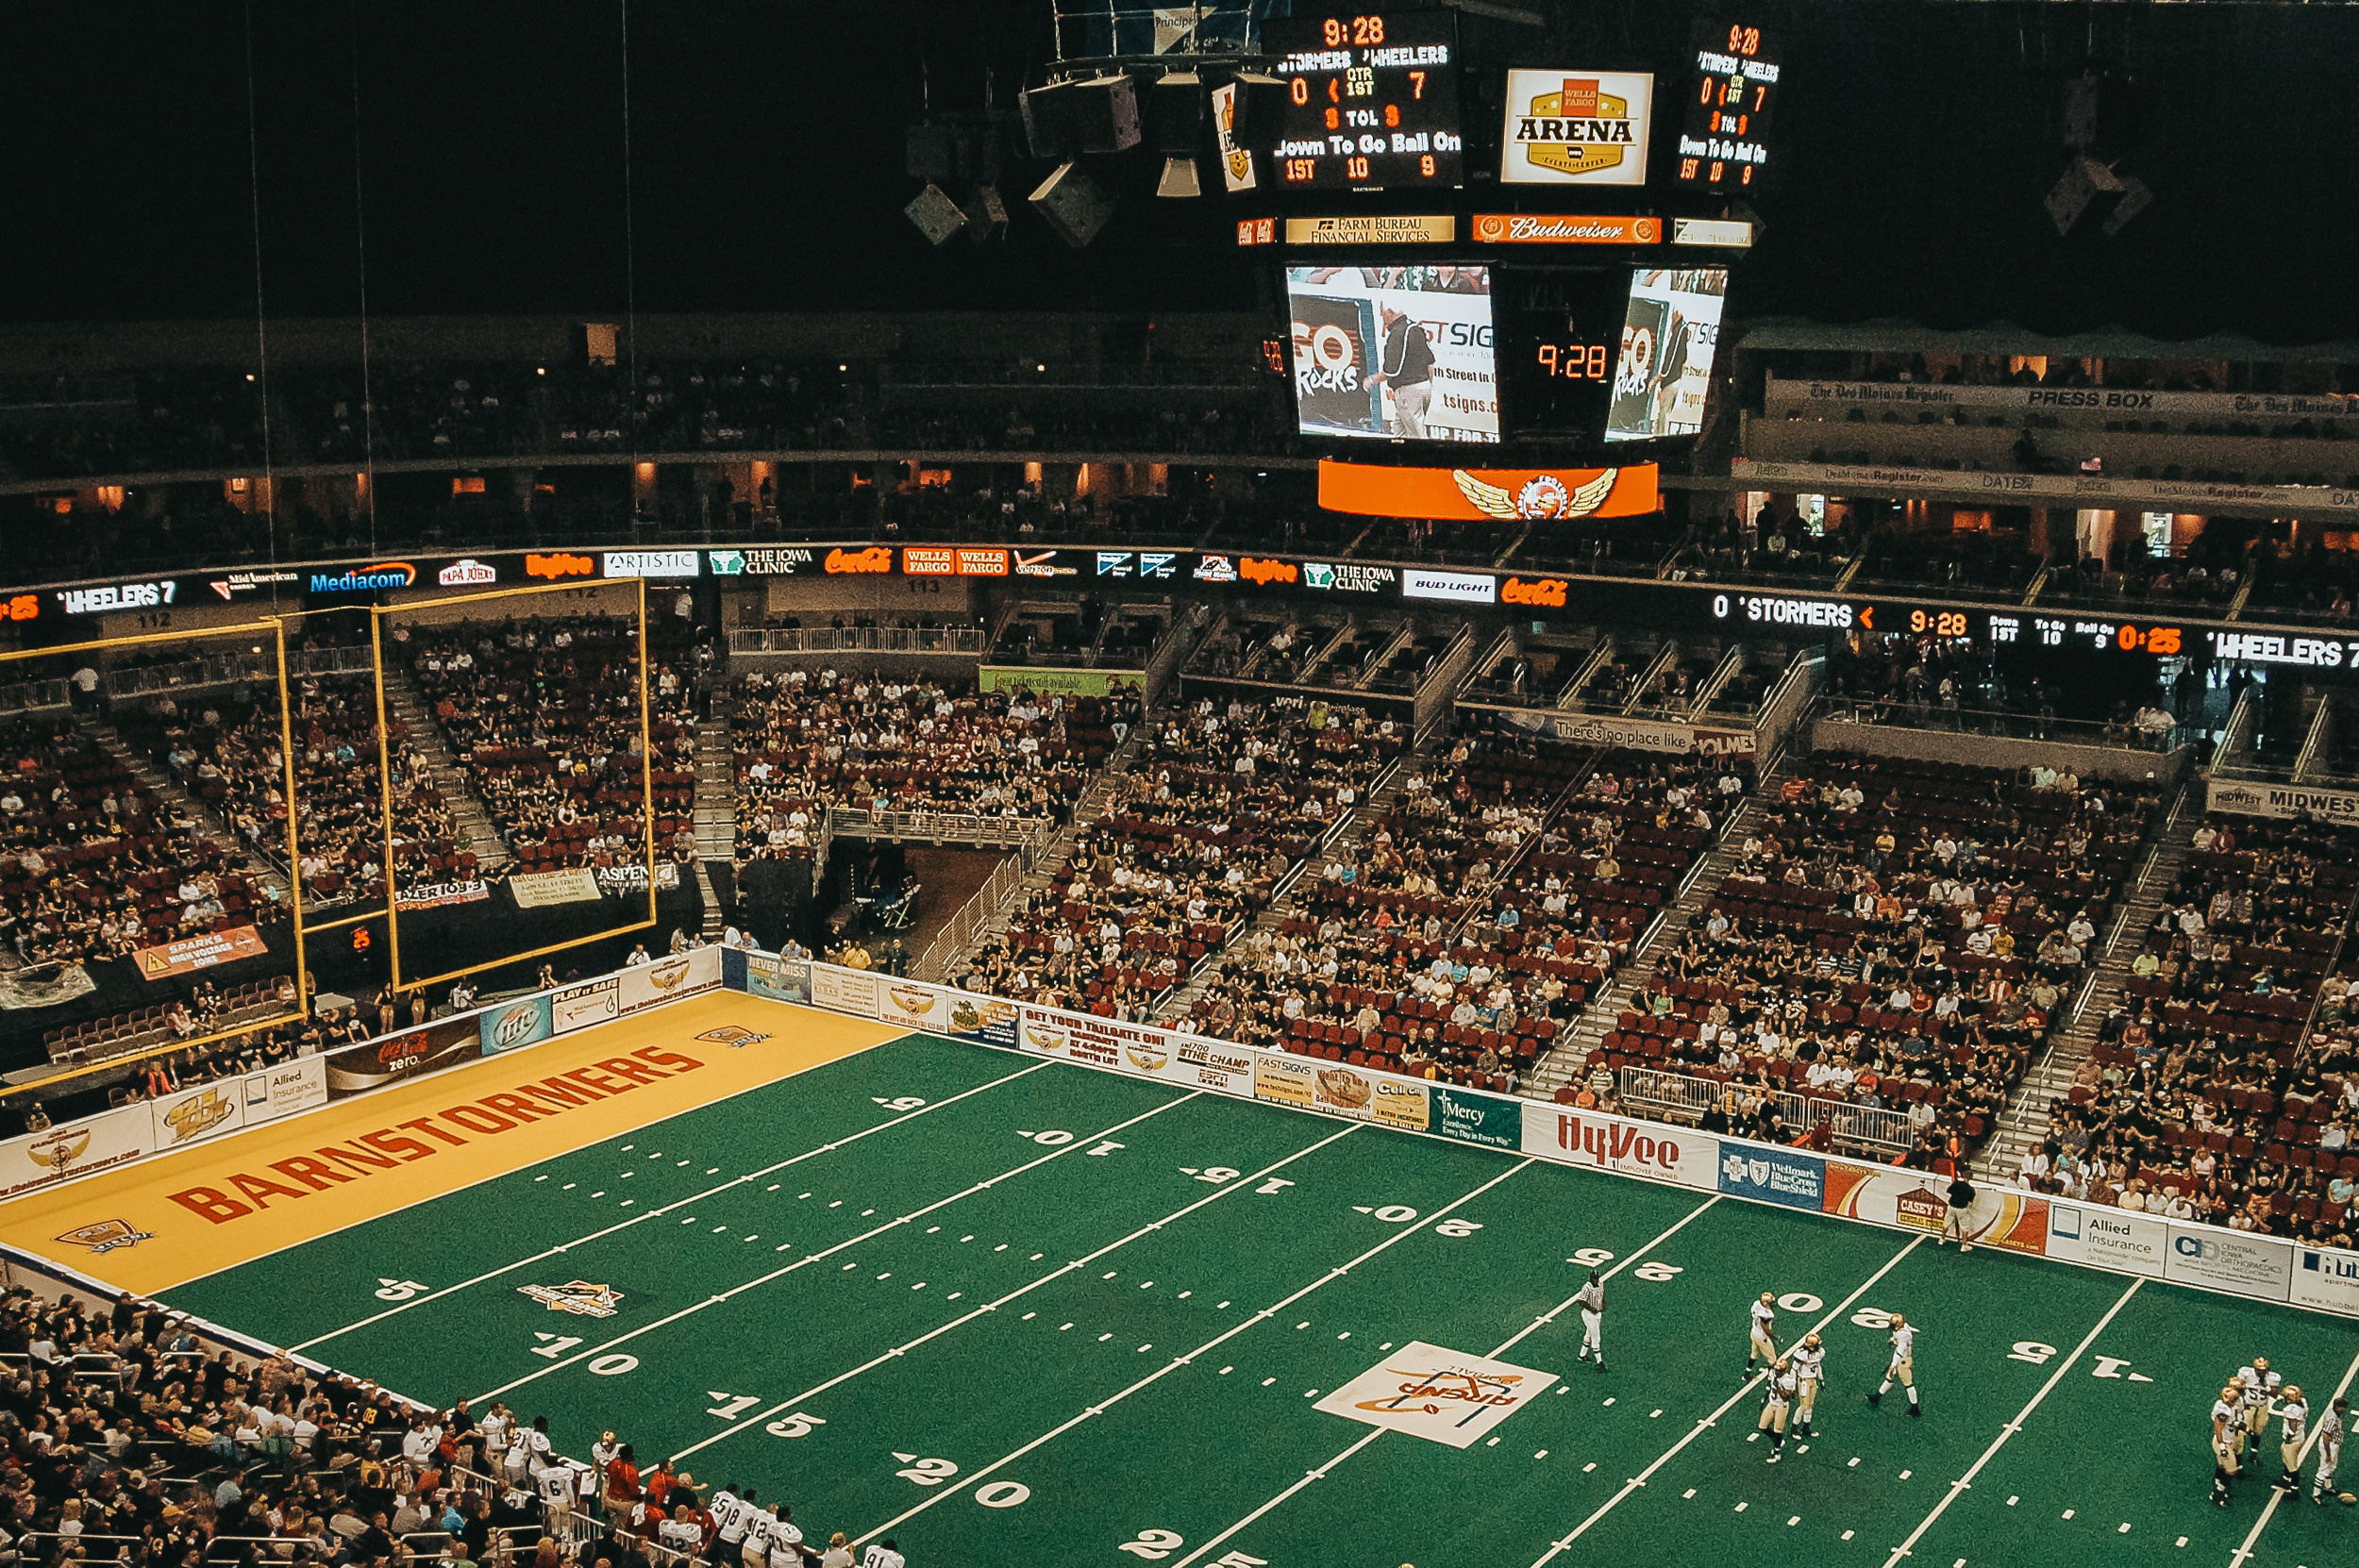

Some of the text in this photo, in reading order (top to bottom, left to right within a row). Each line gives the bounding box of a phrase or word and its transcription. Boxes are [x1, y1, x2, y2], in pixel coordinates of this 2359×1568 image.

[1324, 16, 1384, 45] 9:28
[1729, 24, 1760, 56] 9:28
[1347, 68, 1372, 79] QTR
[1292, 72, 1425, 106] 0 1ST 7
[1564, 90, 1597, 98] WELLS
[1565, 98, 1596, 107] FARGO
[1754, 86, 1765, 112] 7
[1347, 110, 1379, 126] TOL
[1516, 118, 1632, 142] ARENA
[1329, 131, 1461, 155] To Go Ball On
[1286, 155, 1435, 180] 1ST 10 9
[1680, 158, 1752, 185] 1ST 10 9
[1338, 218, 1422, 229] FARM BUREAU
[1510, 217, 1623, 238] Budweiser
[1311, 230, 1430, 242] FINANCIAL SERVICES
[1538, 345, 1606, 377] 9:28
[1446, 368, 1477, 382] Street
[2030, 392, 2153, 409] PRESS BOX
[611, 553, 693, 569] ARTISTIC
[745, 550, 811, 562] THE IOWA
[907, 551, 950, 562] WELLS
[960, 552, 1004, 563] WELLS
[745, 562, 795, 574] CLINIC
[909, 562, 950, 573] FARGO
[962, 563, 1004, 574] FARGO
[1335, 564, 1395, 581] THE IOWA
[310, 572, 406, 592] Mediacom
[909, 579, 940, 593] 113
[1335, 576, 1380, 592] CLINIC
[1414, 579, 1492, 592] BUD LIGHT
[161, 581, 176, 603] 7
[1739, 595, 1852, 628] 'STORMERS
[1911, 609, 1966, 636] 9:28
[1991, 626, 2107, 649] 1ST 10 9
[2118, 625, 2182, 654] 0:25
[1557, 722, 1686, 748] There's no place like
[2269, 791, 2359, 813] MIDWES
[169, 934, 224, 954] SPARKS
[192, 942, 234, 959] VOLTAGE
[192, 955, 219, 967] ZONE
[748, 956, 807, 978] NEVER MISS
[553, 988, 581, 1004] PLAY
[593, 978, 618, 993] SAFE
[1025, 1009, 1047, 1024] GET
[1049, 1013, 1082, 1030] YOUR
[1084, 1020, 1140, 1042] TAILGATE
[389, 1055, 419, 1072] zero
[1185, 1049, 1250, 1069] THE CHAMP
[1257, 1057, 1312, 1075] FASTSIGNS
[273, 1070, 302, 1087] Allied
[274, 1080, 317, 1099] Insurance
[1376, 1083, 1406, 1095] Cell
[1447, 1102, 1485, 1126] Mercy
[165, 1045, 706, 1225] BARNSTORMERS
[1770, 1180, 1818, 1197] BlueShield
[1771, 1172, 1817, 1188] BlueCross
[1900, 1198, 1945, 1219] CASEY'S
[2090, 1218, 2131, 1237] Allied
[2088, 1232, 2152, 1254] Insurance
[2221, 1243, 2258, 1256] CENTRAL
[375, 1279, 430, 1301] 5
[548, 1479, 561, 1497] 6
